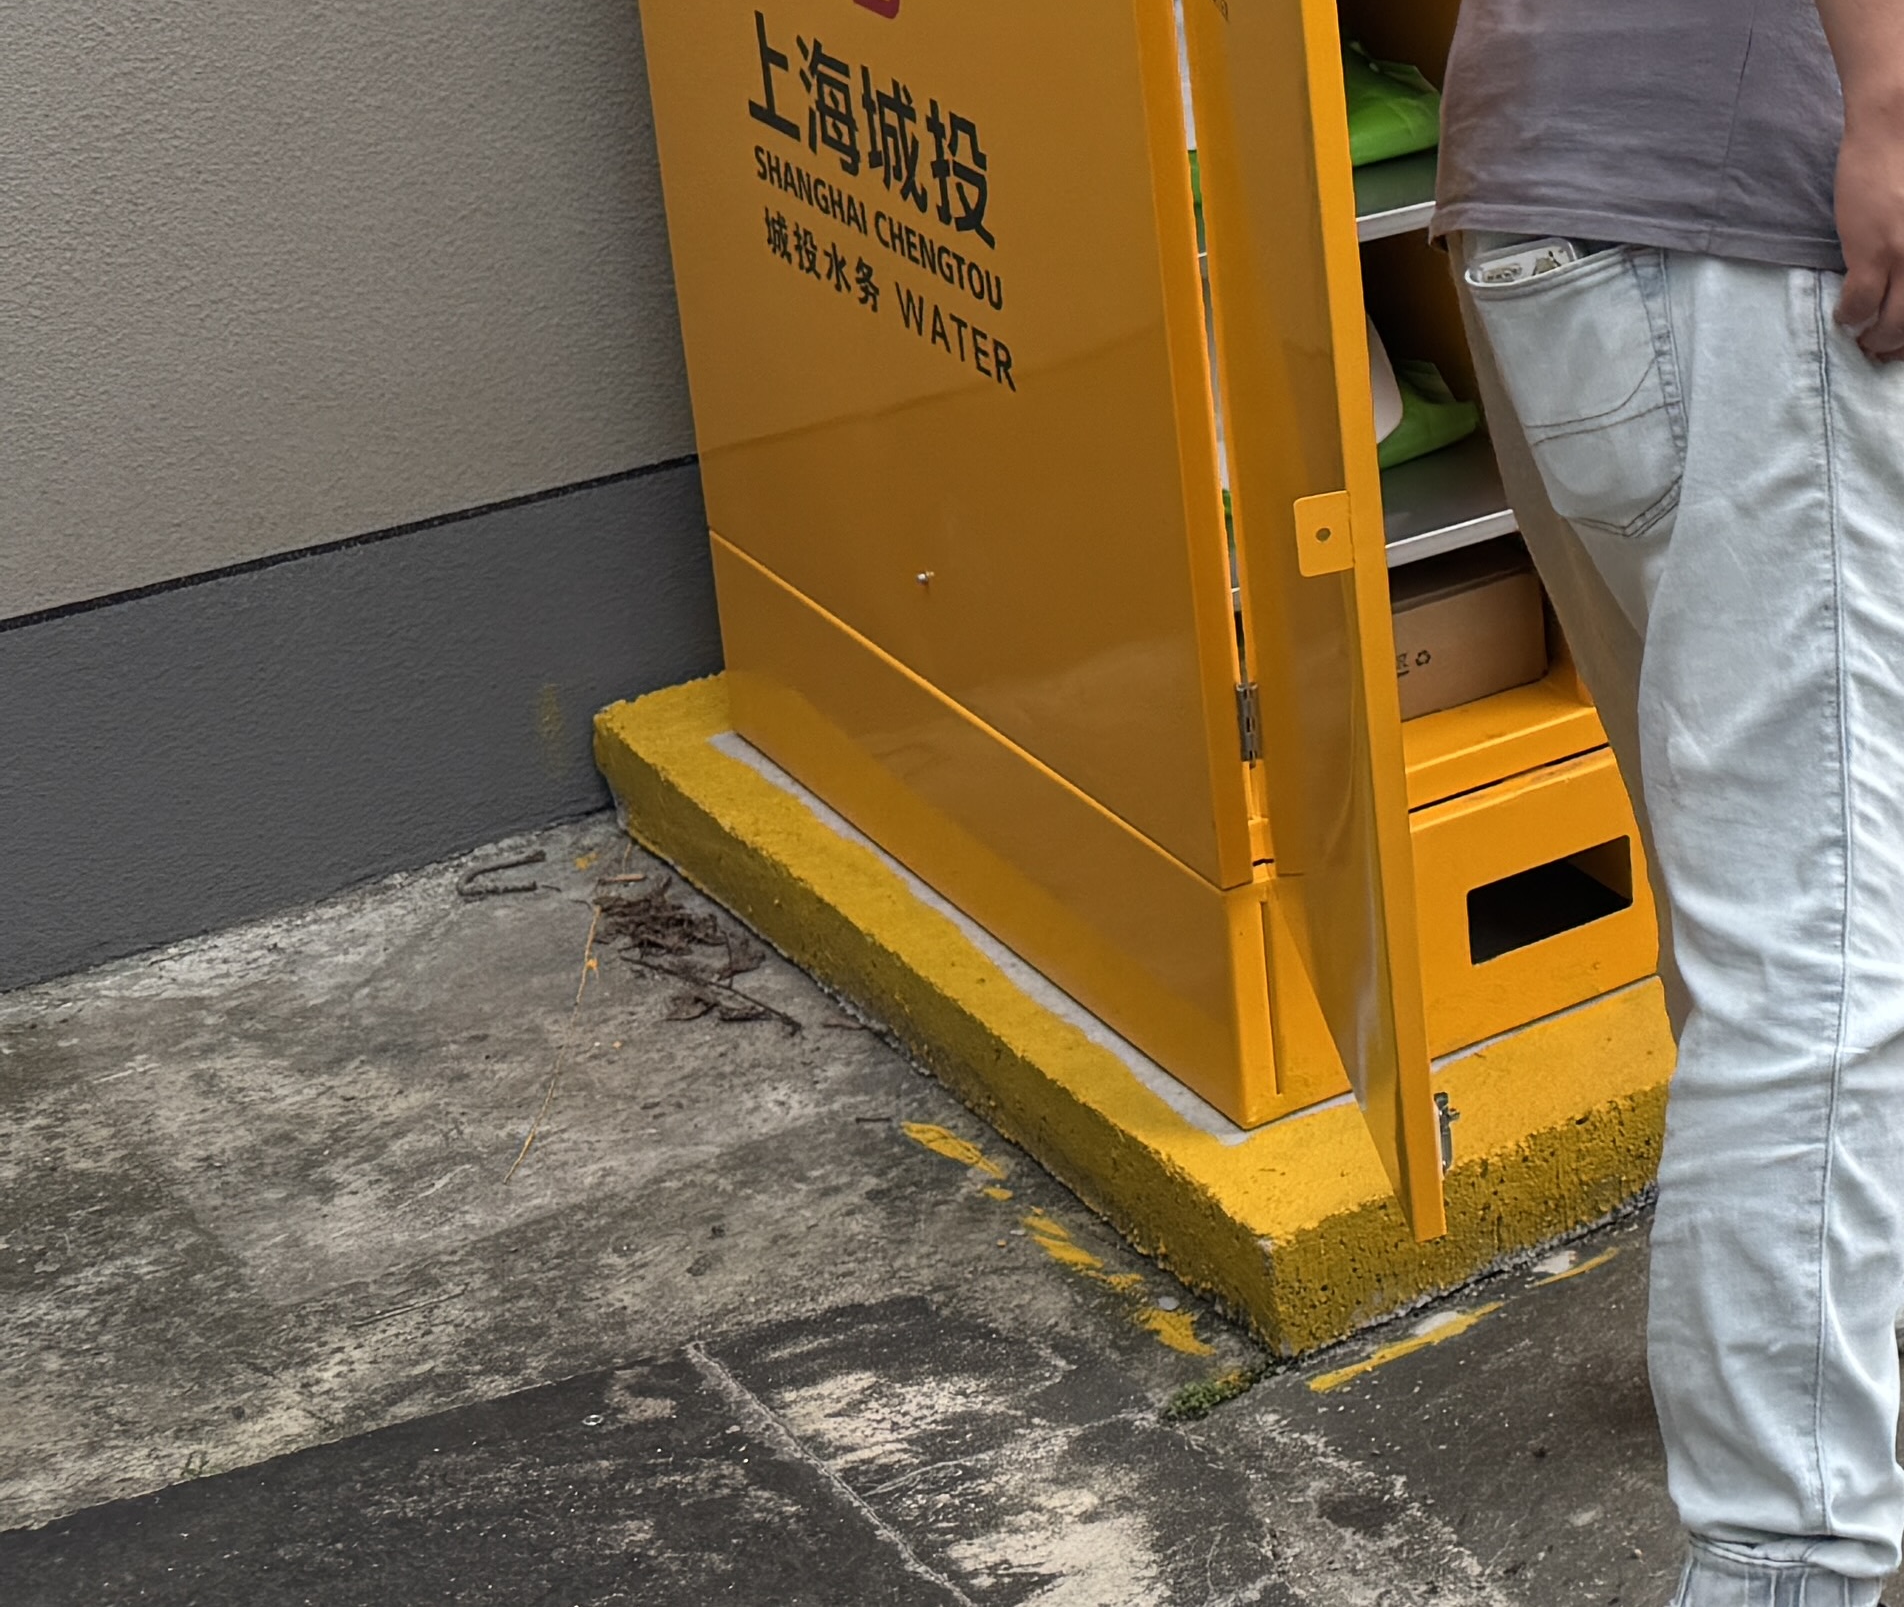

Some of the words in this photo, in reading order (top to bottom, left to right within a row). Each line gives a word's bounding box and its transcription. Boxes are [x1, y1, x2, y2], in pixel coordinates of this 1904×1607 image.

[748, 10, 996, 248] 上海城投
[753, 145, 868, 237] SHANGHAI
[874, 209, 1004, 310] CHENGTOU
[763, 206, 880, 314] 城投水务
[895, 280, 1017, 392] WATER
